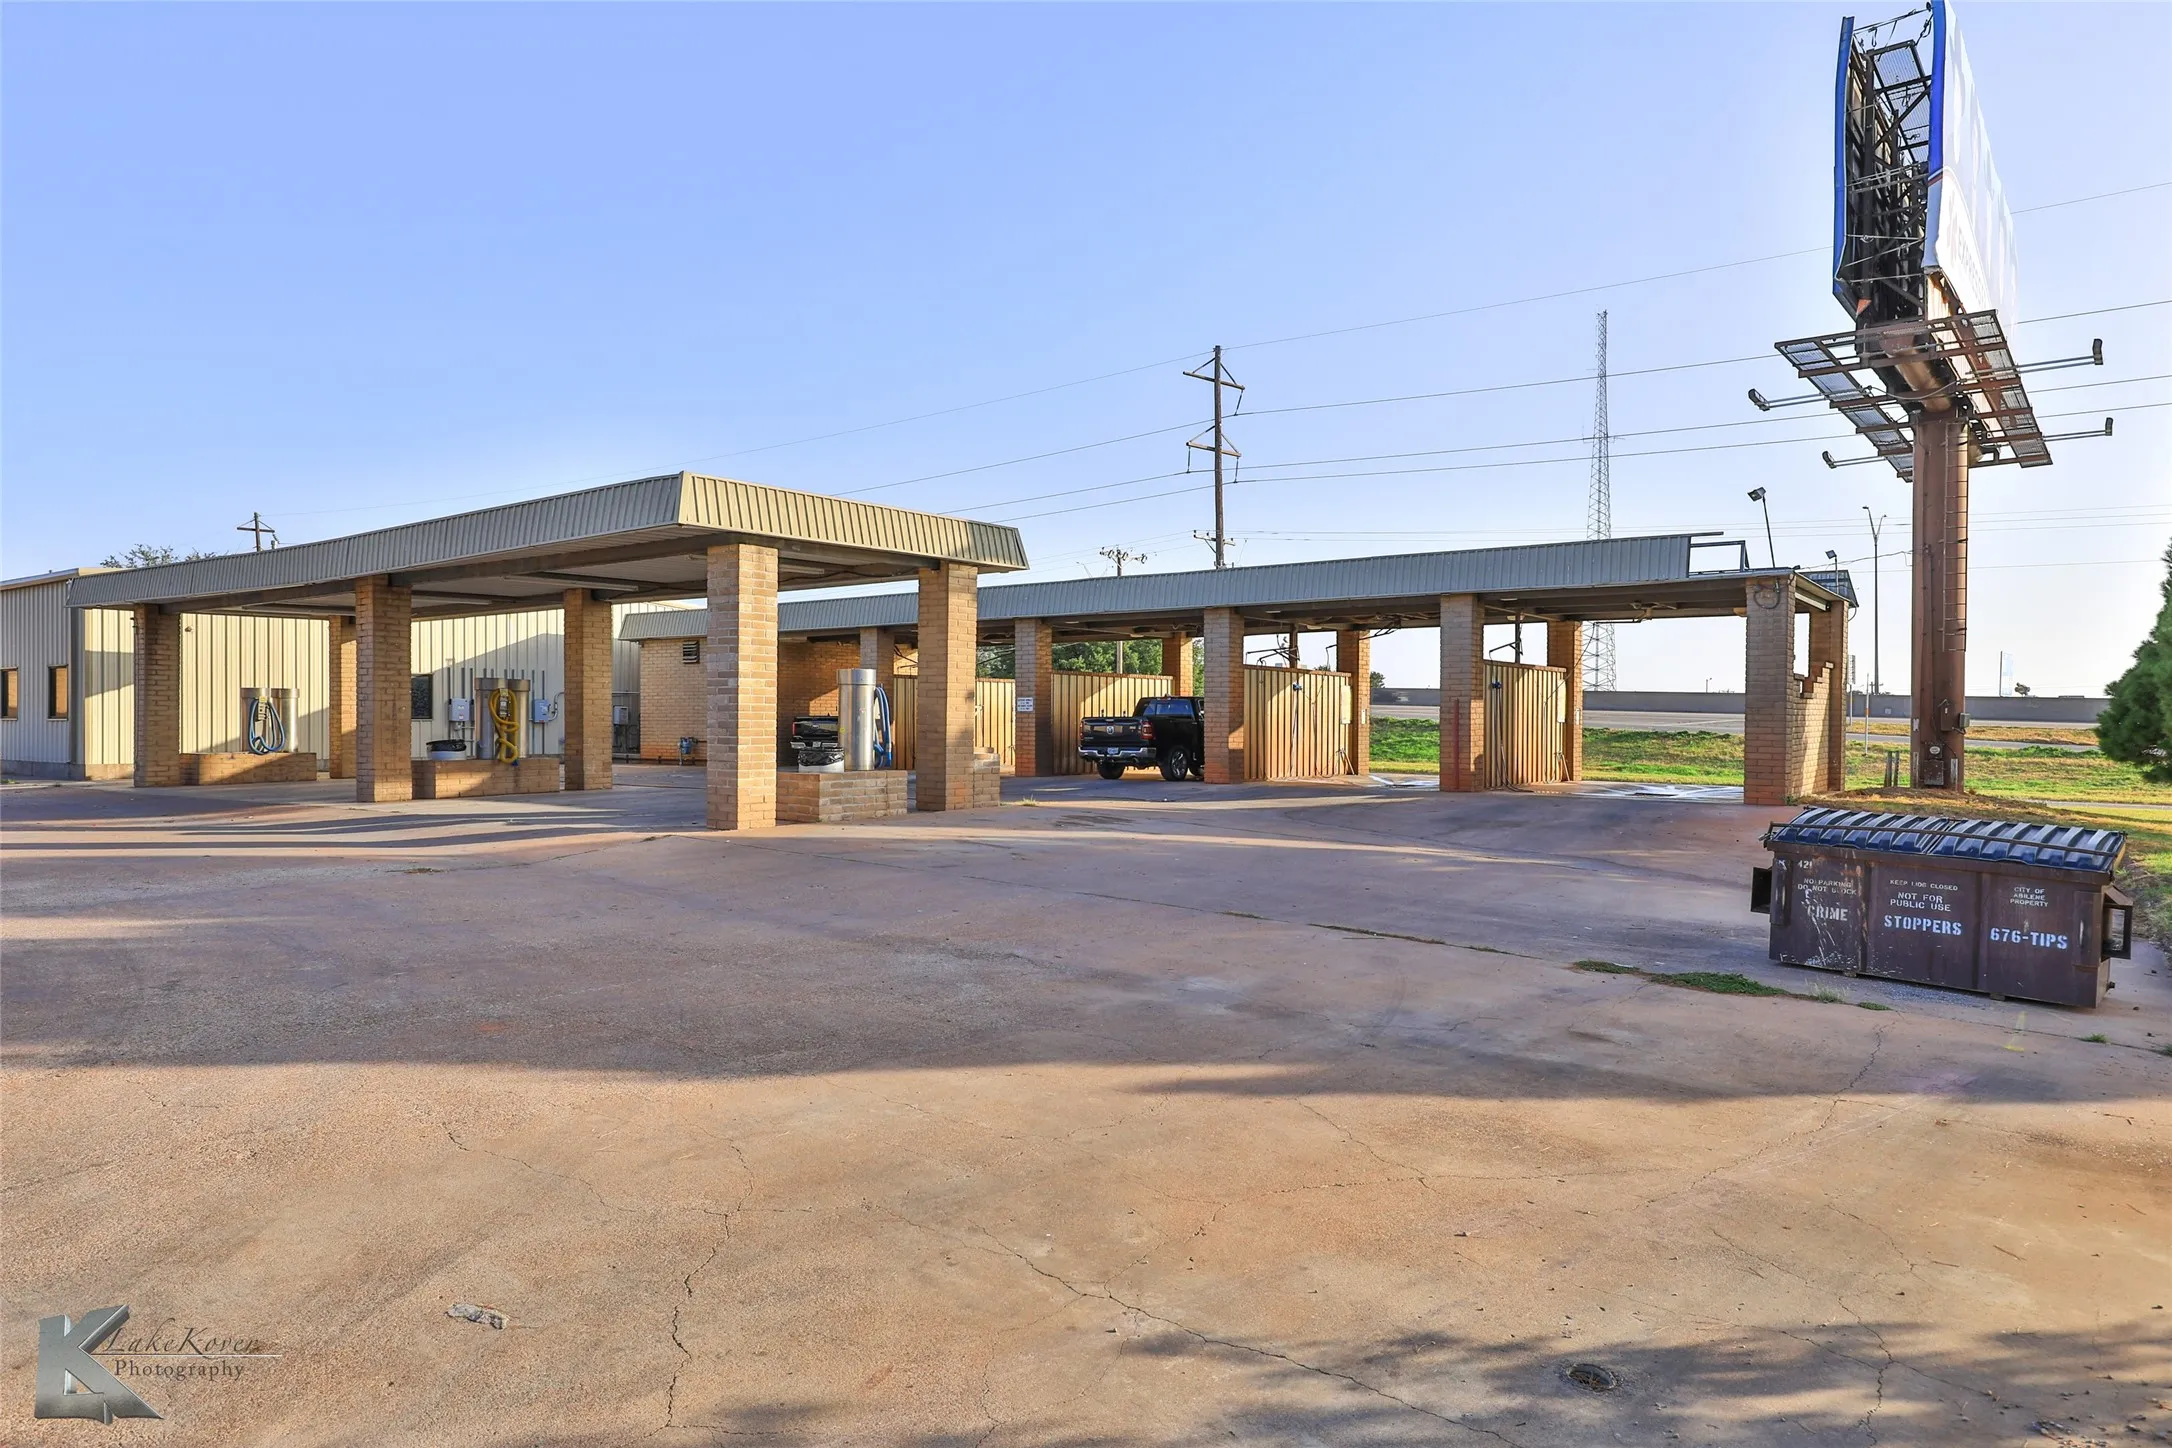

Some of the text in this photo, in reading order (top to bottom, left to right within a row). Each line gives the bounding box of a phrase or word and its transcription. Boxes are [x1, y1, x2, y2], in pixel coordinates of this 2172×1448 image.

[1818, 879, 1852, 888] PARKING
[1930, 883, 1958, 891] CLOSED
[1897, 892, 1943, 904] NOT FOR
[2009, 898, 2049, 908] PROPERTY
[2013, 893, 2046, 901] ABILENE
[1890, 899, 1951, 912] PUBLIC USE
[1807, 905, 1848, 921] CRIME
[1884, 915, 1962, 936] STOPPERS
[1990, 927, 2068, 949] 676-TIPS
